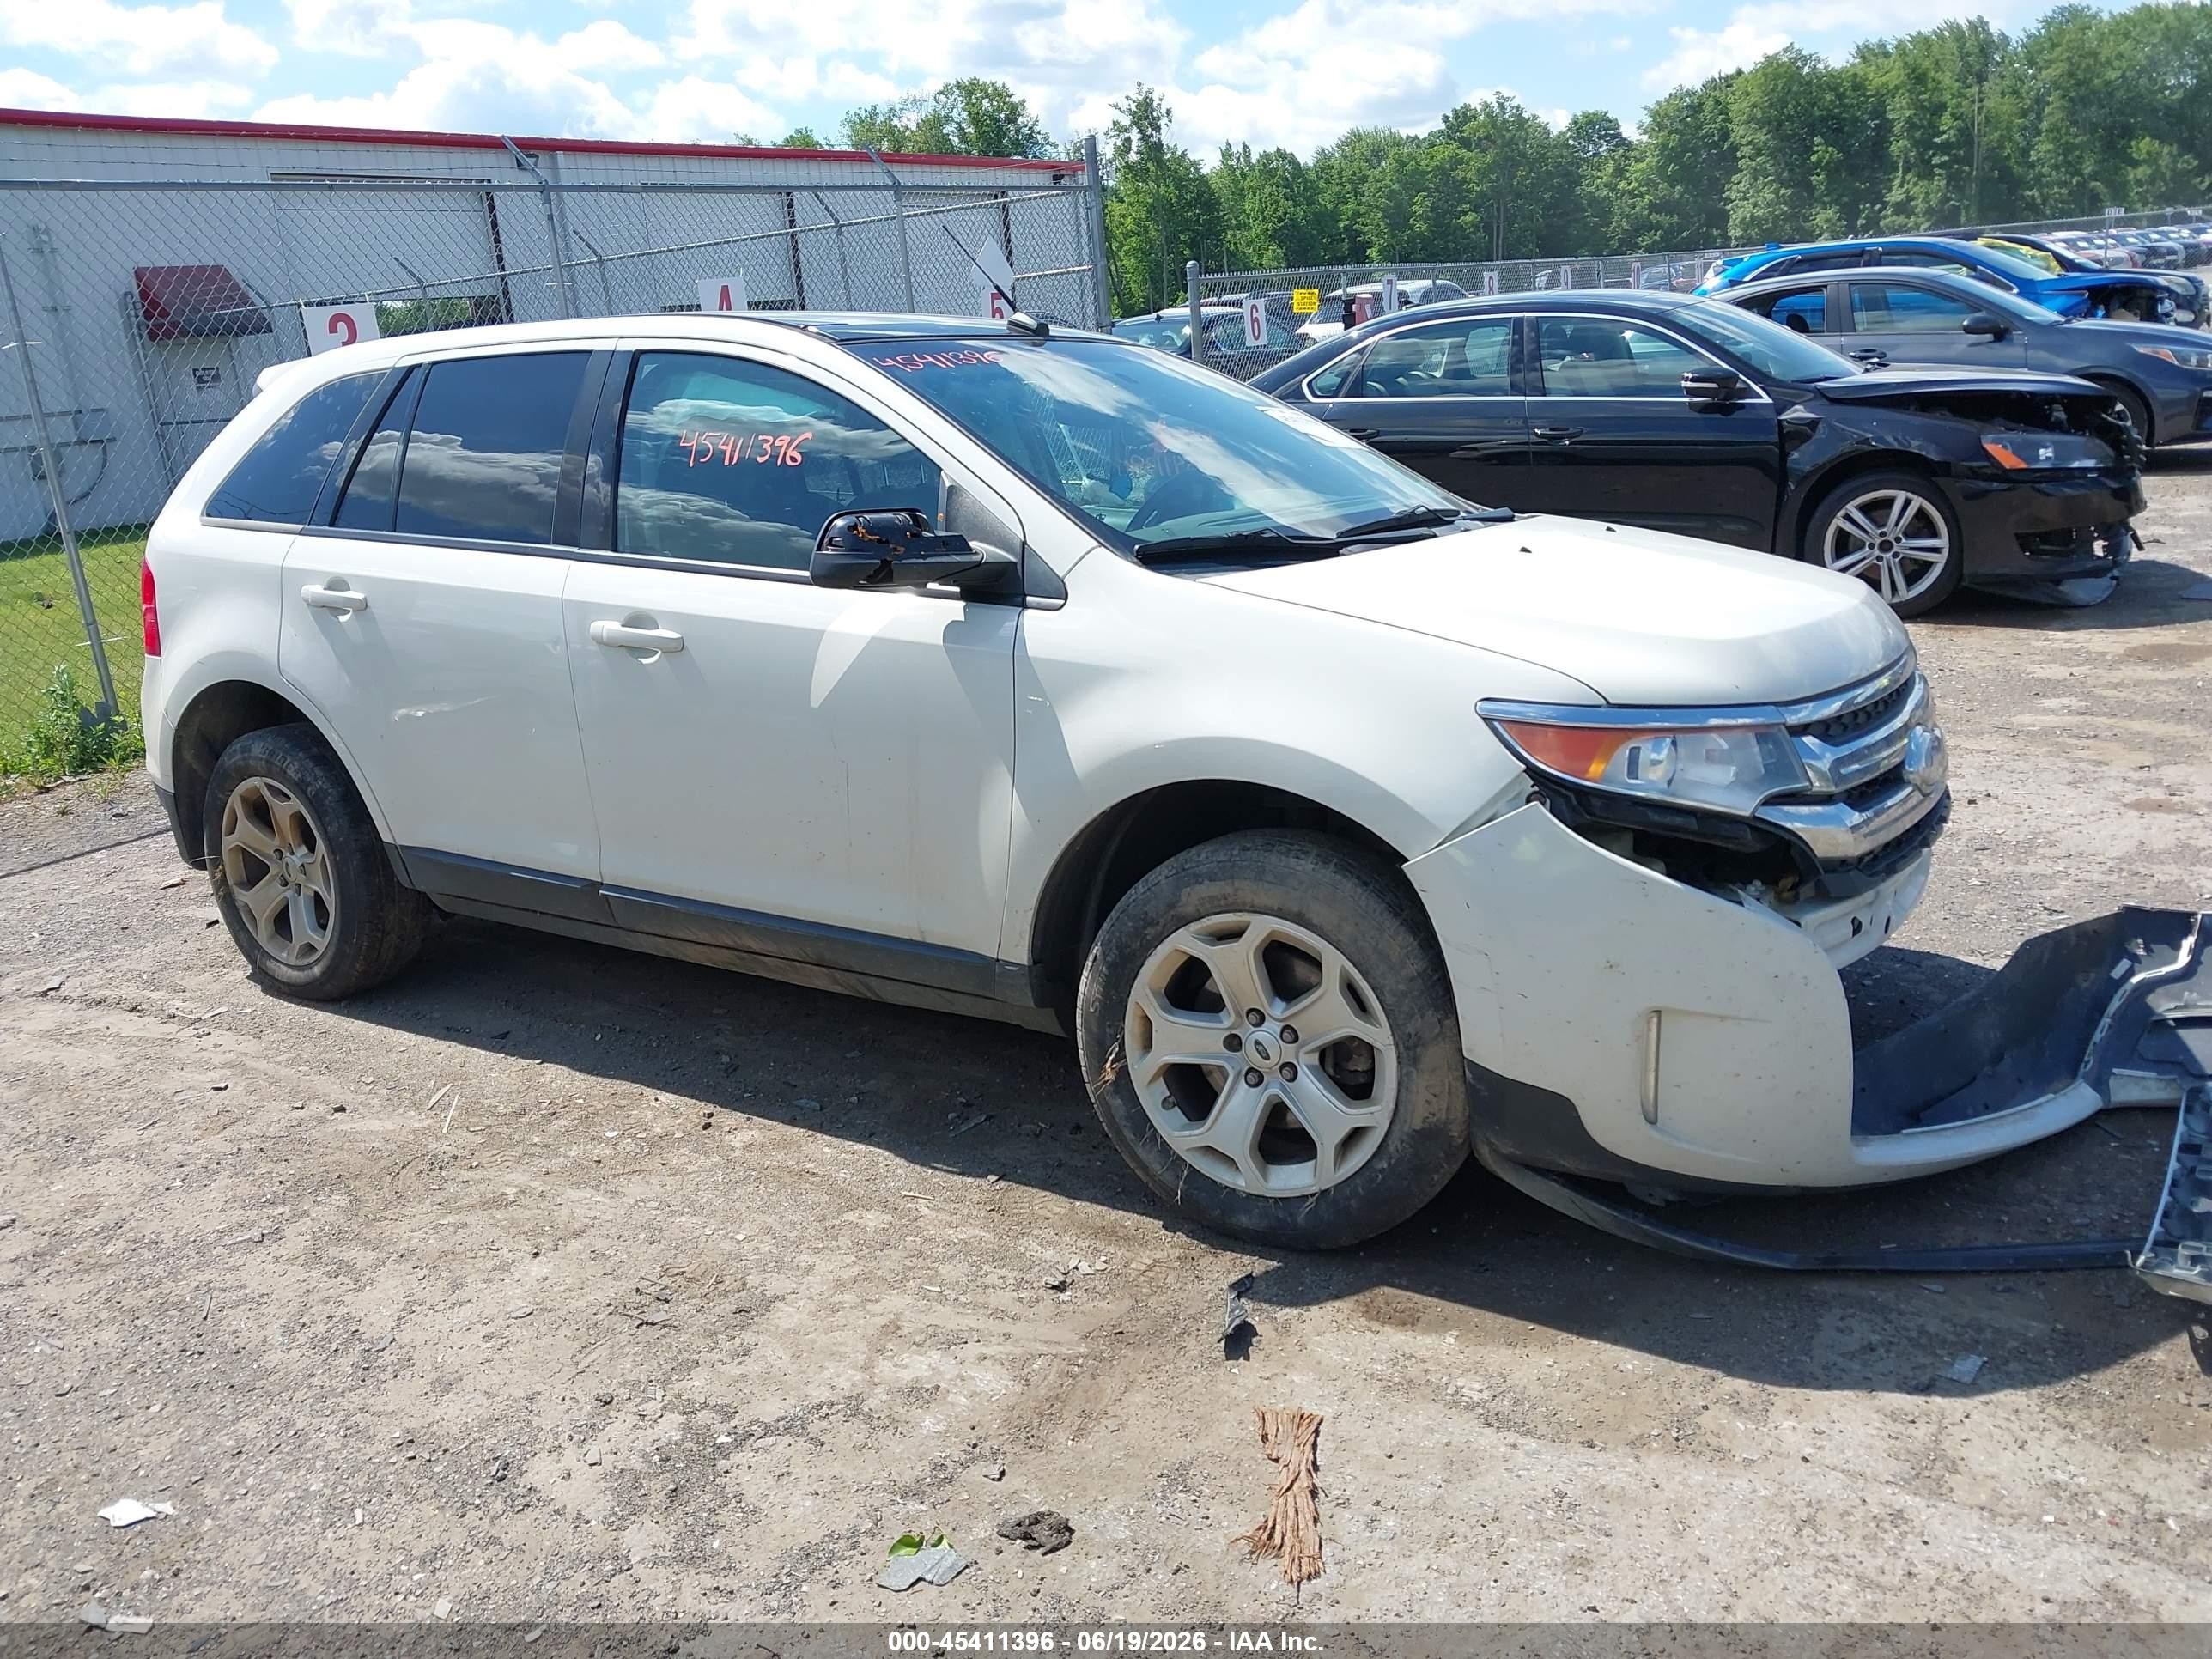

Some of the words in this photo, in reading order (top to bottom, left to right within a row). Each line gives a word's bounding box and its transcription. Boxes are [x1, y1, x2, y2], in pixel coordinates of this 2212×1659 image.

[1386, 278, 1393, 310] 7
[1249, 303, 1261, 341] 6
[679, 429, 813, 467] 45411396
